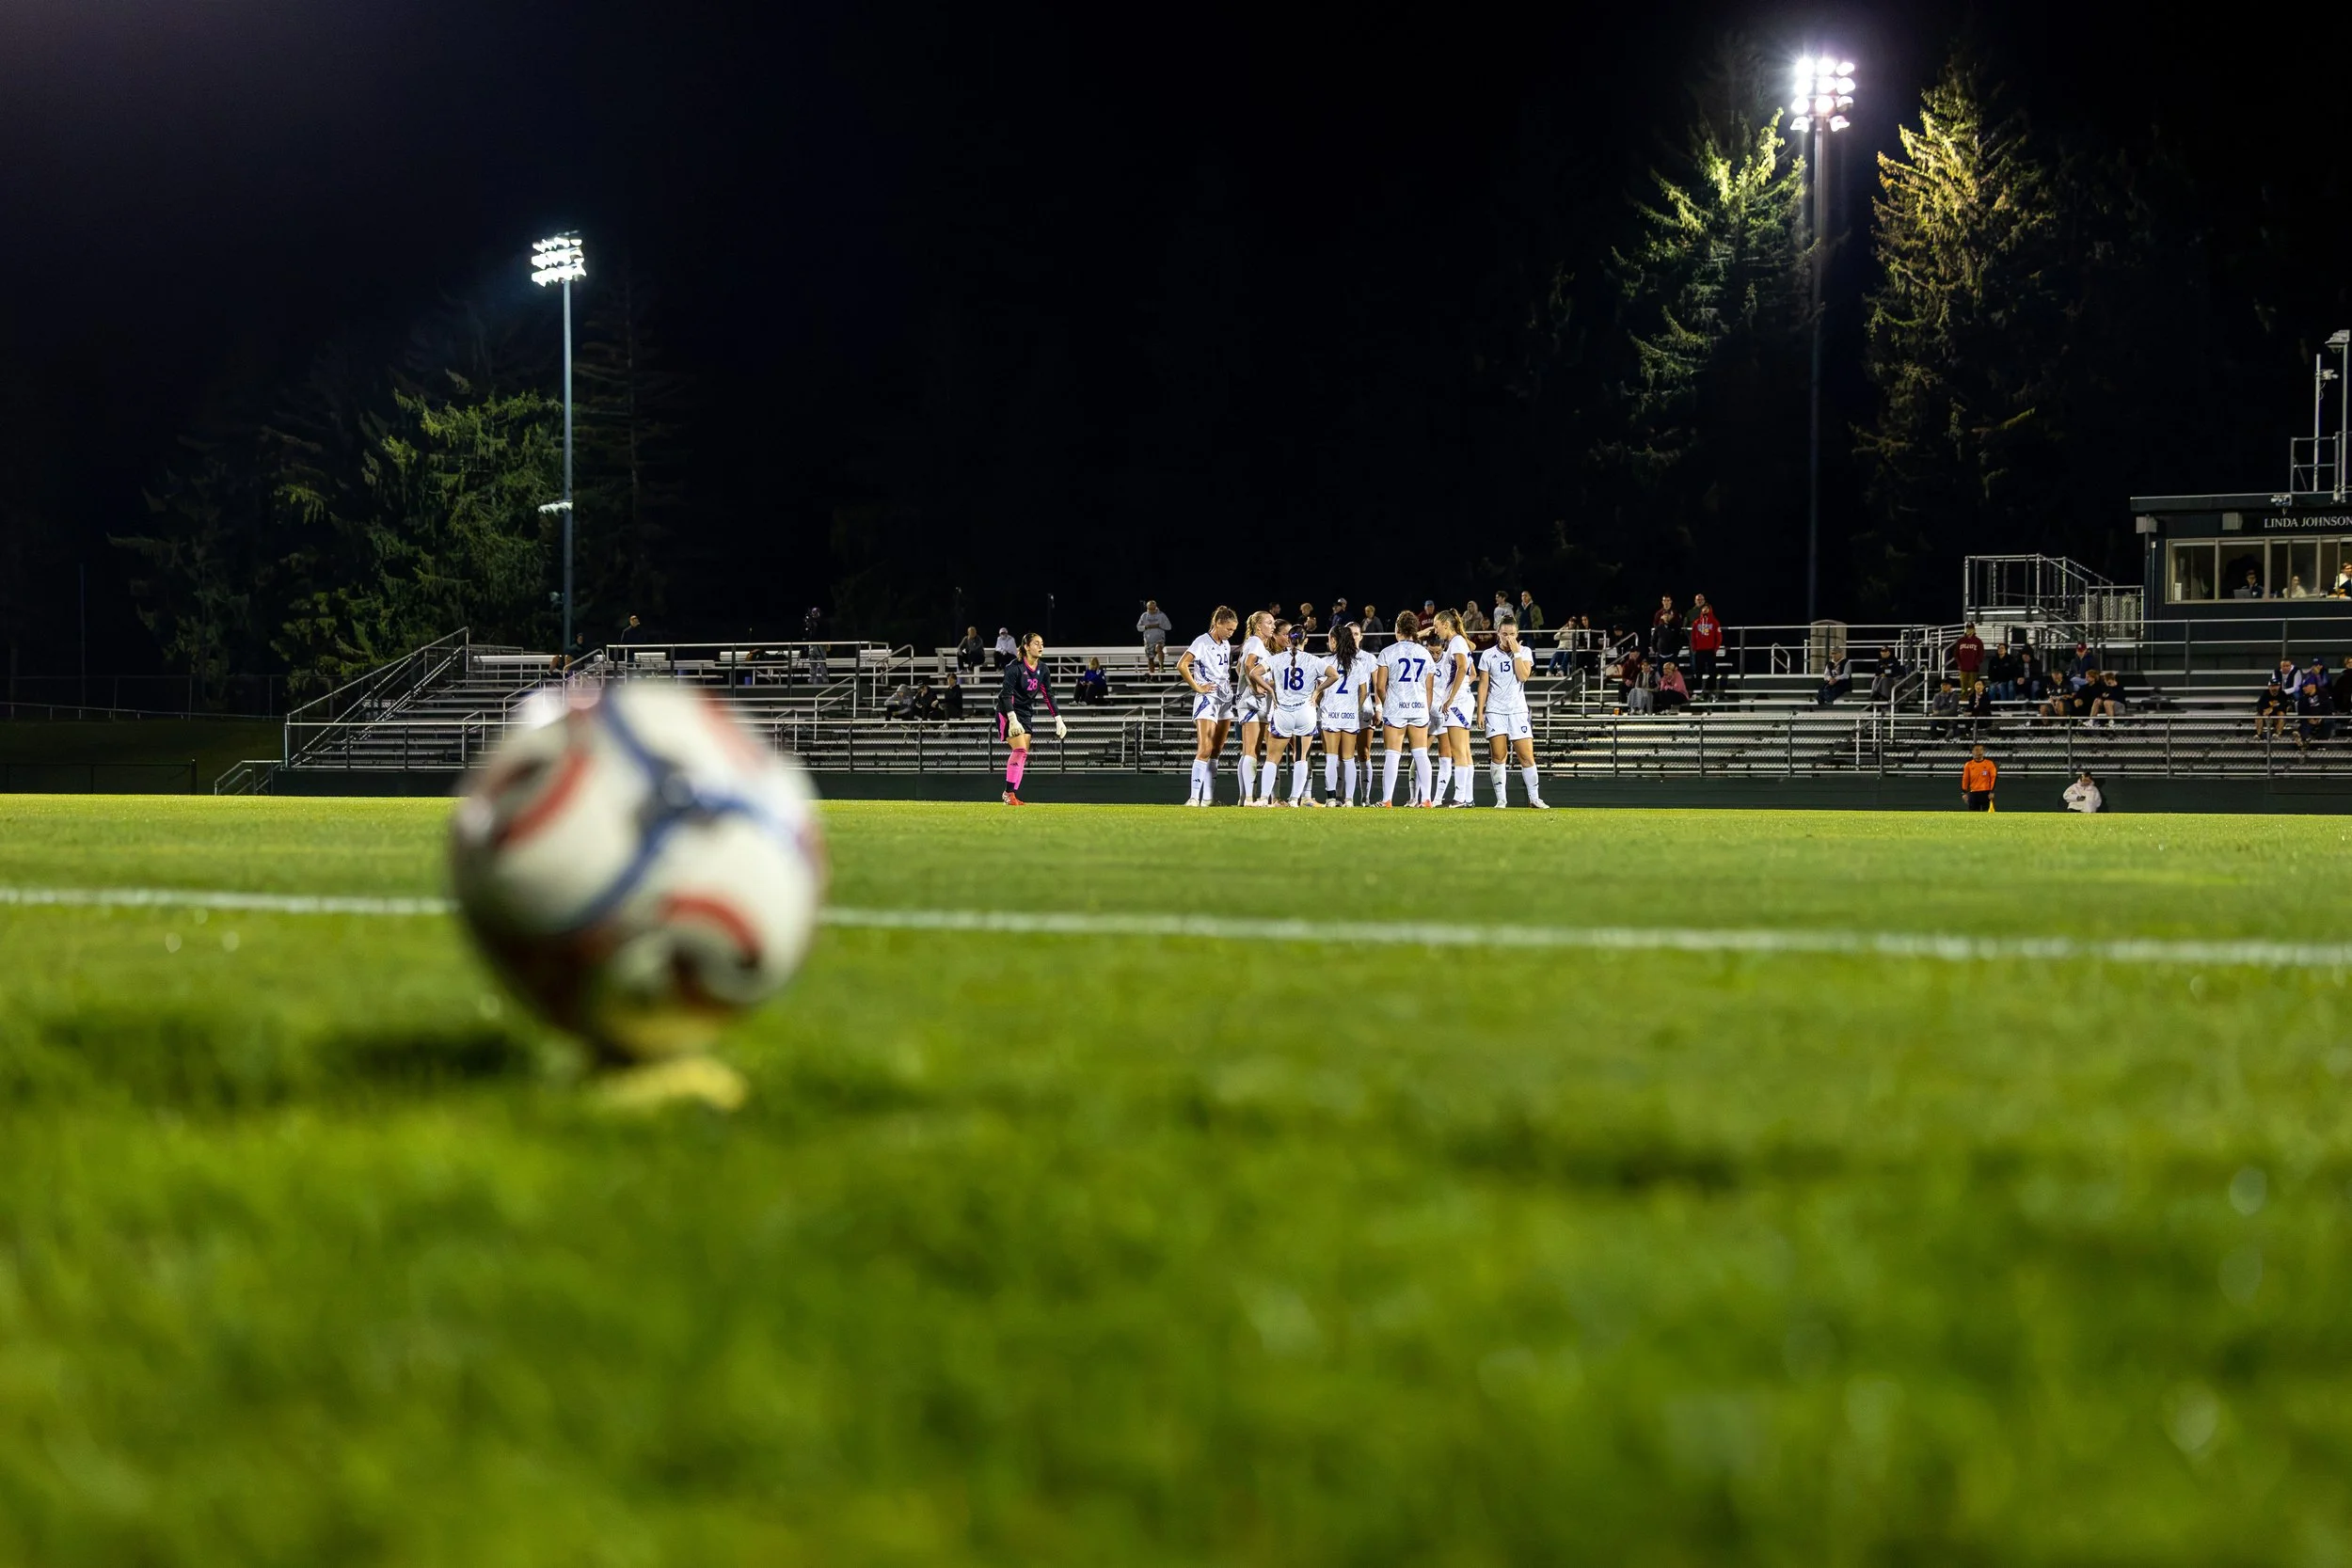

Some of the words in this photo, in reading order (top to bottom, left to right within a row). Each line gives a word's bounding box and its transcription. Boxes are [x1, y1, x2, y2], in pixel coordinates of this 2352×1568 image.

[2264, 517, 2298, 529] LINDA
[2301, 515, 2352, 527] JOHNSON
[1216, 654, 1229, 666] 24
[1500, 660, 1511, 673] 13
[1397, 657, 1426, 683] 27
[1026, 677, 1039, 691] 28
[1283, 667, 1304, 691] 18
[1335, 669, 1349, 694] 2
[1398, 701, 1410, 709] HOLY
[1327, 711, 1340, 720] HOLY
[1341, 711, 1356, 720] CROSS
